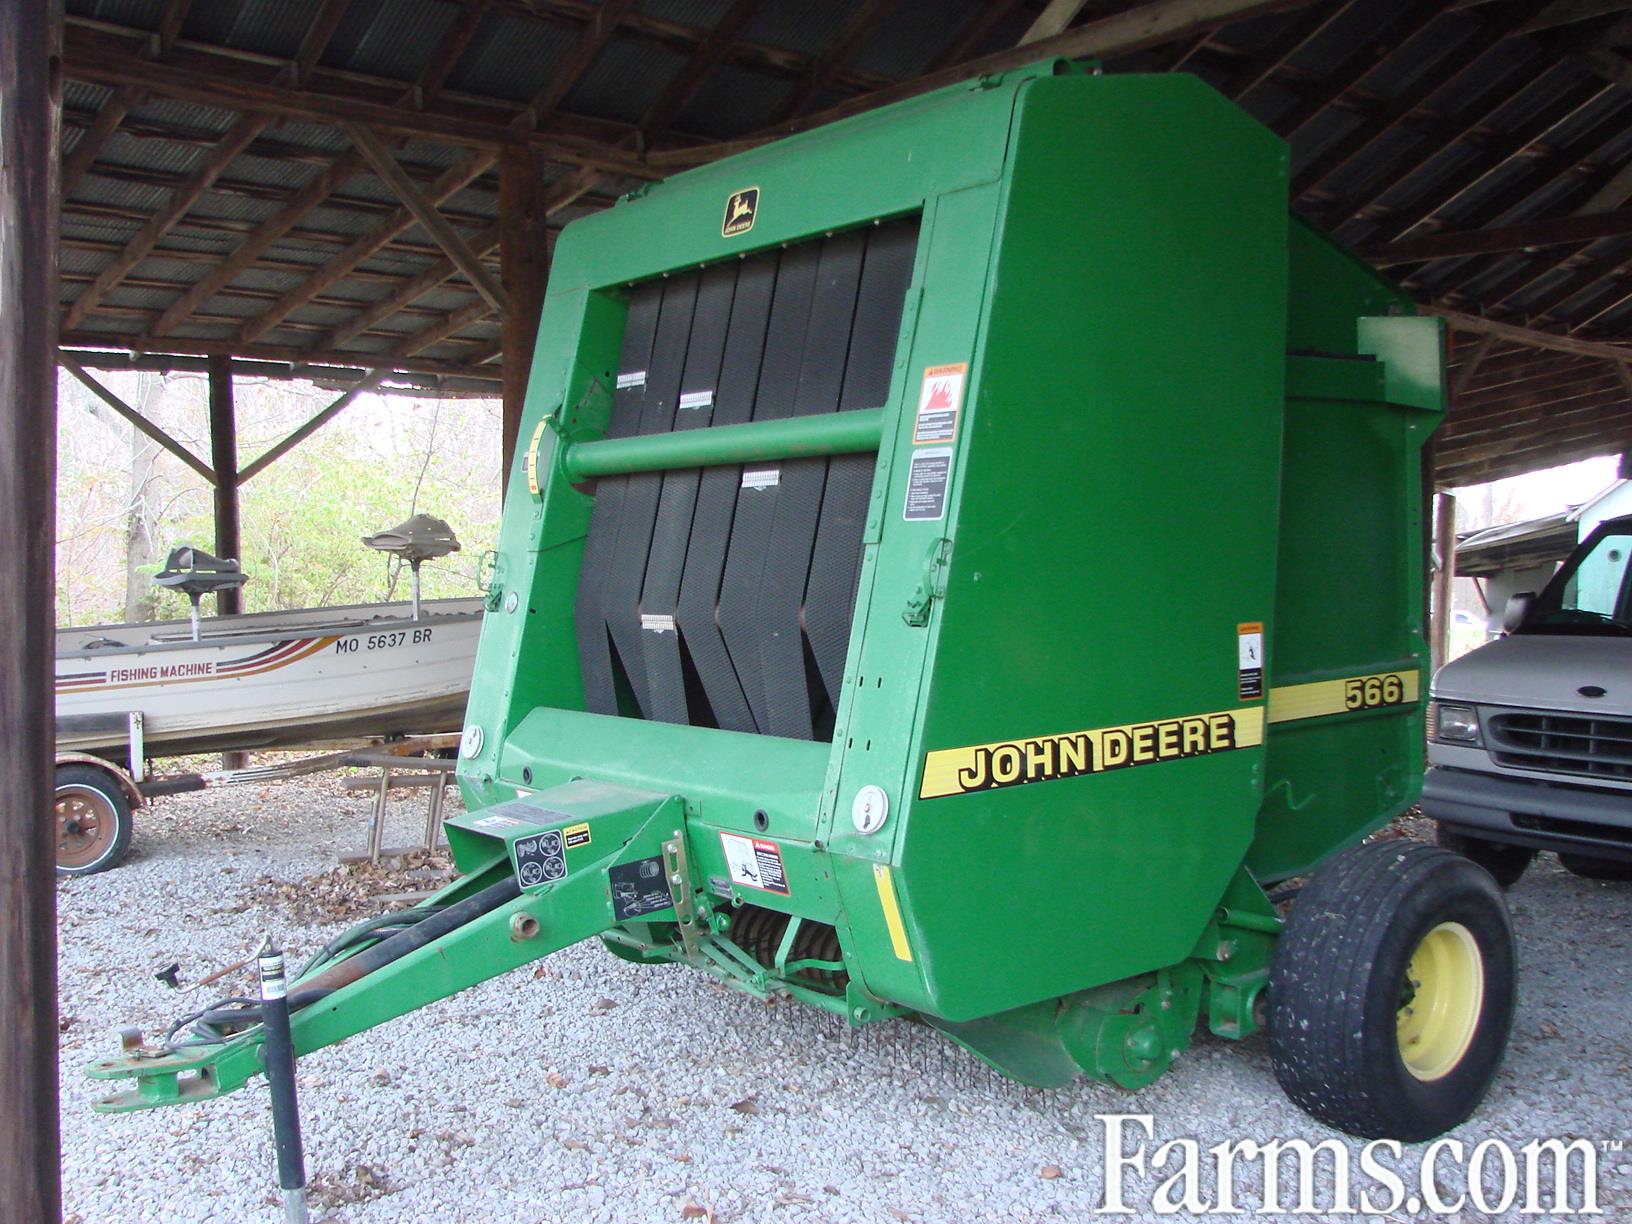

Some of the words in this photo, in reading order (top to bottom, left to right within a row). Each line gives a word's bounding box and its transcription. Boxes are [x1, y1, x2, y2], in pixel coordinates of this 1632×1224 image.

[336, 638, 359, 654] MO
[367, 633, 405, 650] 5637
[412, 628, 432, 644] BR
[110, 666, 158, 682] FISHING
[160, 662, 213, 679] MACHINE
[1344, 674, 1403, 709] 566
[958, 735, 1093, 791] JOHN
[1101, 714, 1235, 766] DEERE
